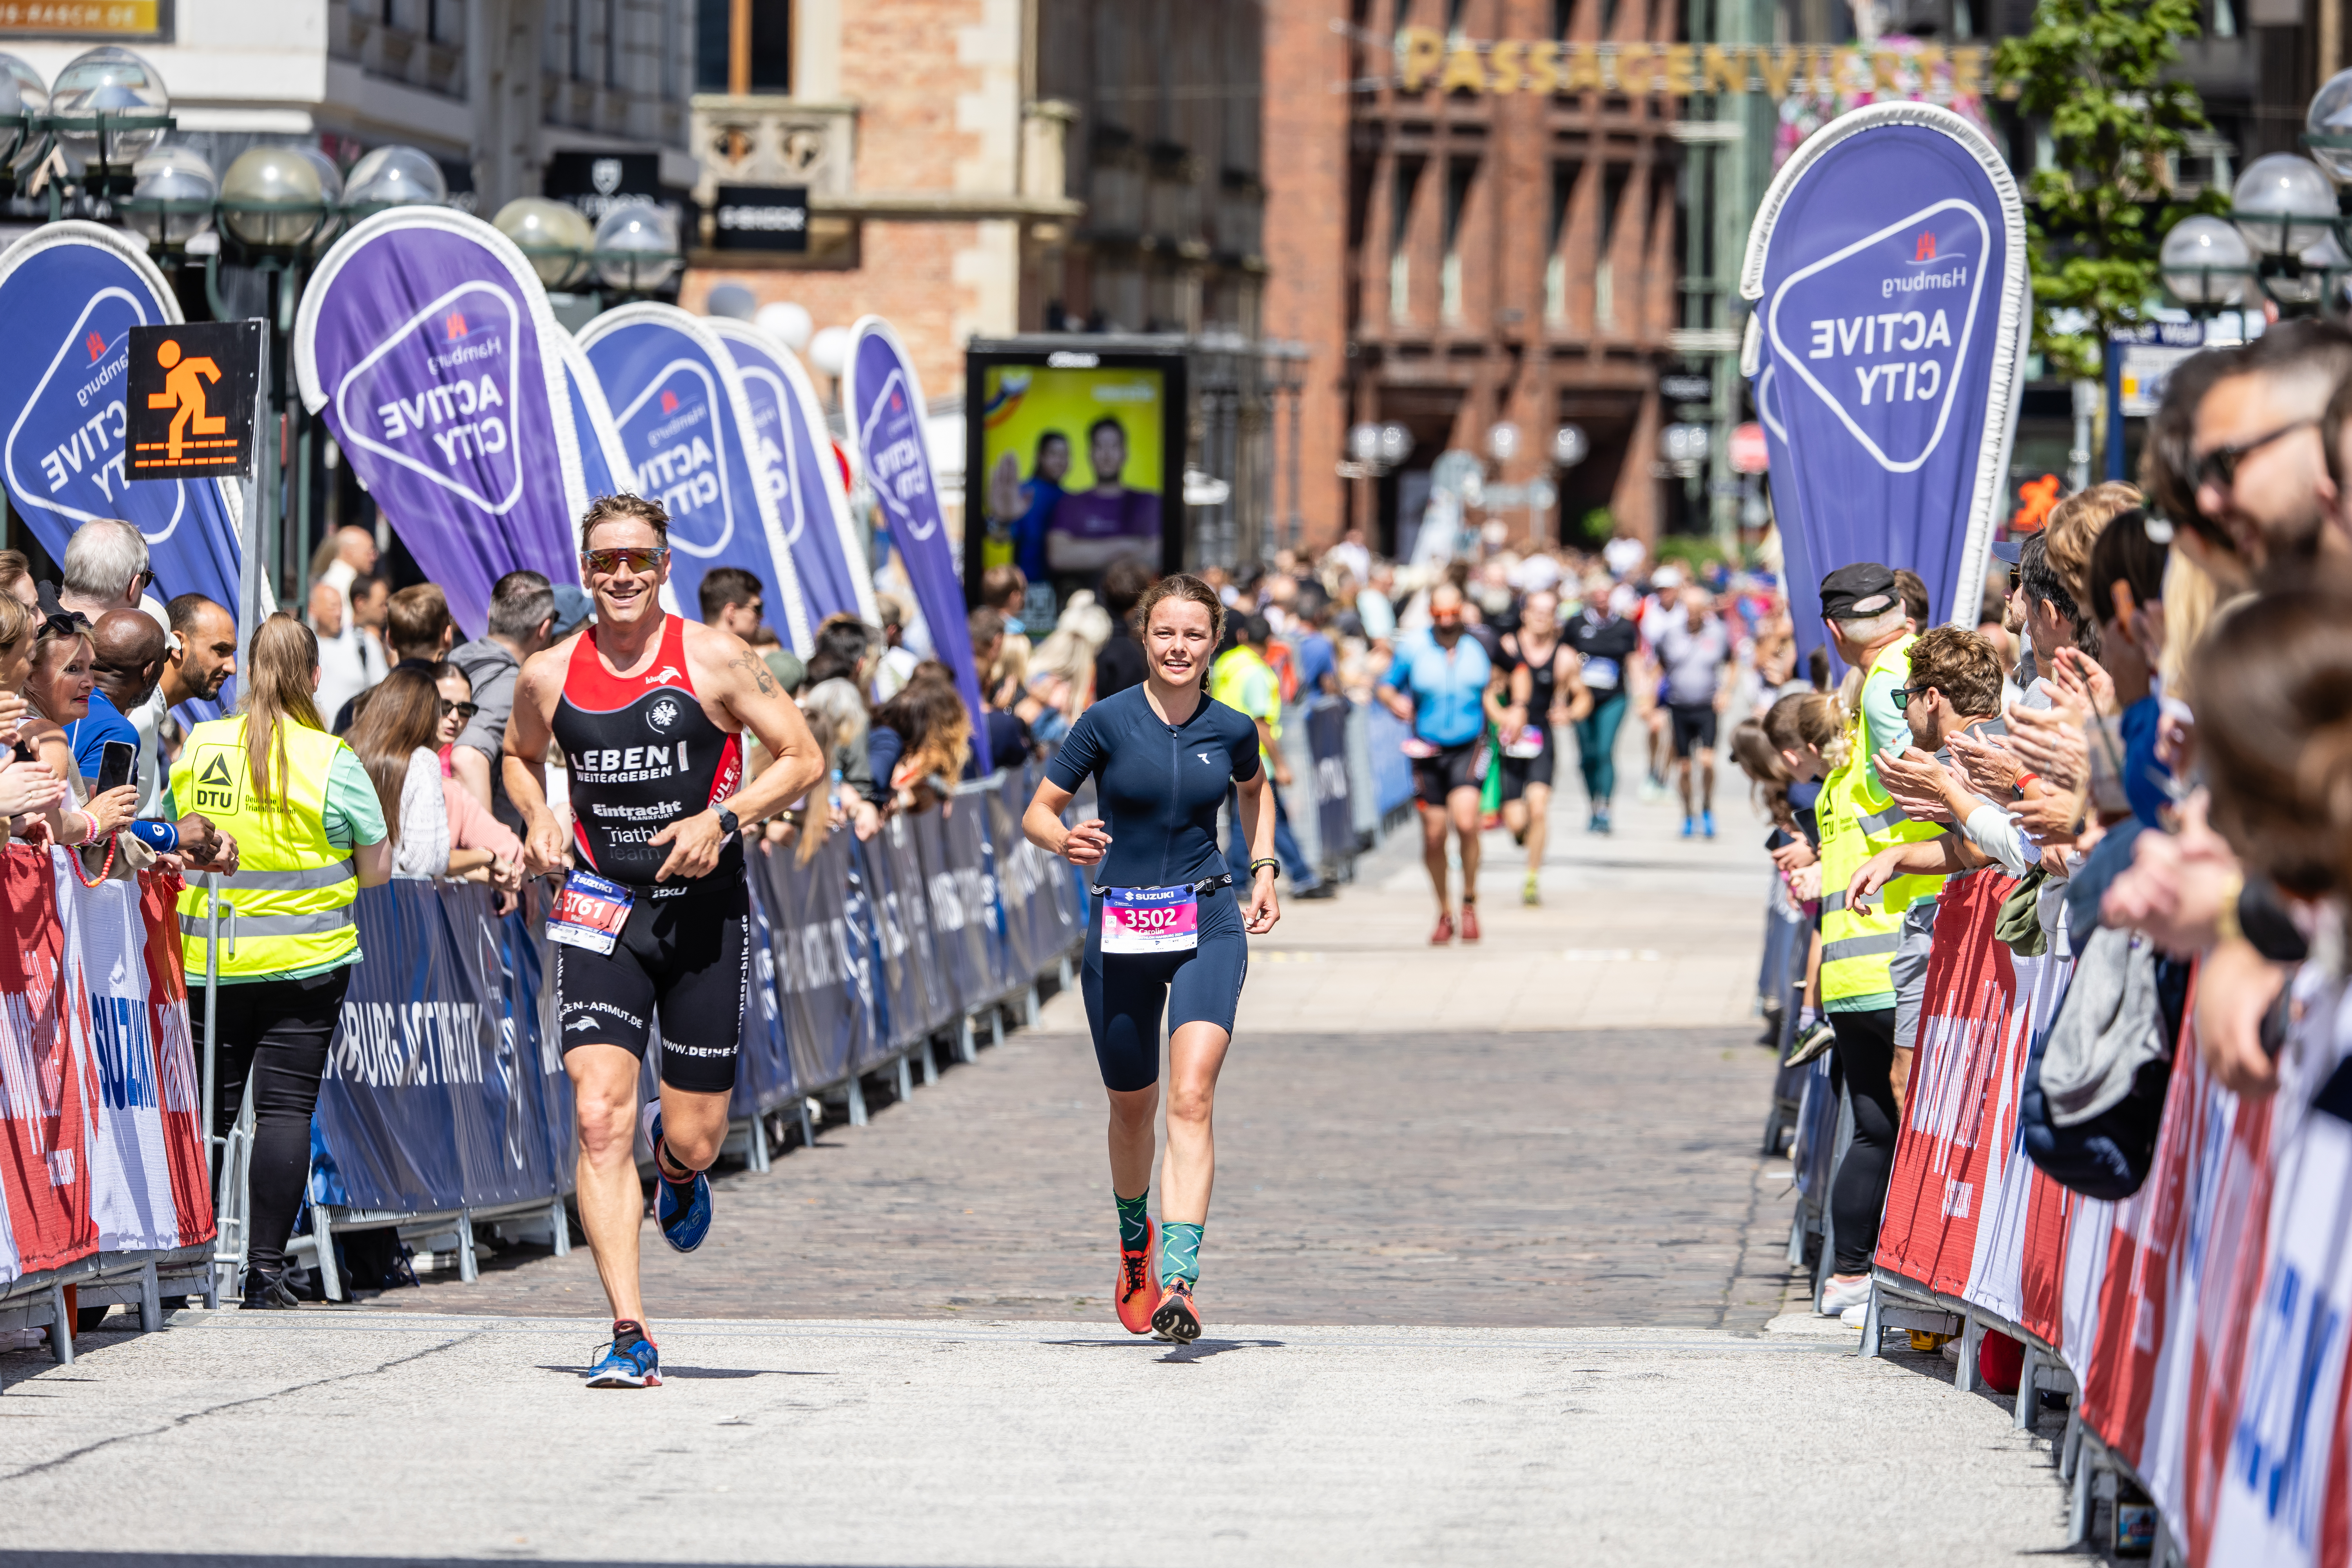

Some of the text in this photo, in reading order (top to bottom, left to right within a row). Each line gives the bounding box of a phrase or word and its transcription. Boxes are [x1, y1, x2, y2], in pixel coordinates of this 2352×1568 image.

[571, 745, 670, 771] LEBEN
[576, 766, 672, 783] WEITERGEBEN
[197, 789, 232, 808] DTU
[592, 801, 682, 817] Eintracht
[628, 813, 673, 821] FRANKFURT
[1822, 820, 1834, 837] TU
[578, 877, 613, 894] SUZUKI
[1136, 891, 1174, 900] SUZUKI
[564, 892, 606, 919] 3761
[1125, 908, 1177, 928] 3502
[92, 992, 156, 1111] SUZUKI
[1947, 1178, 1973, 1218] SUZUKI
